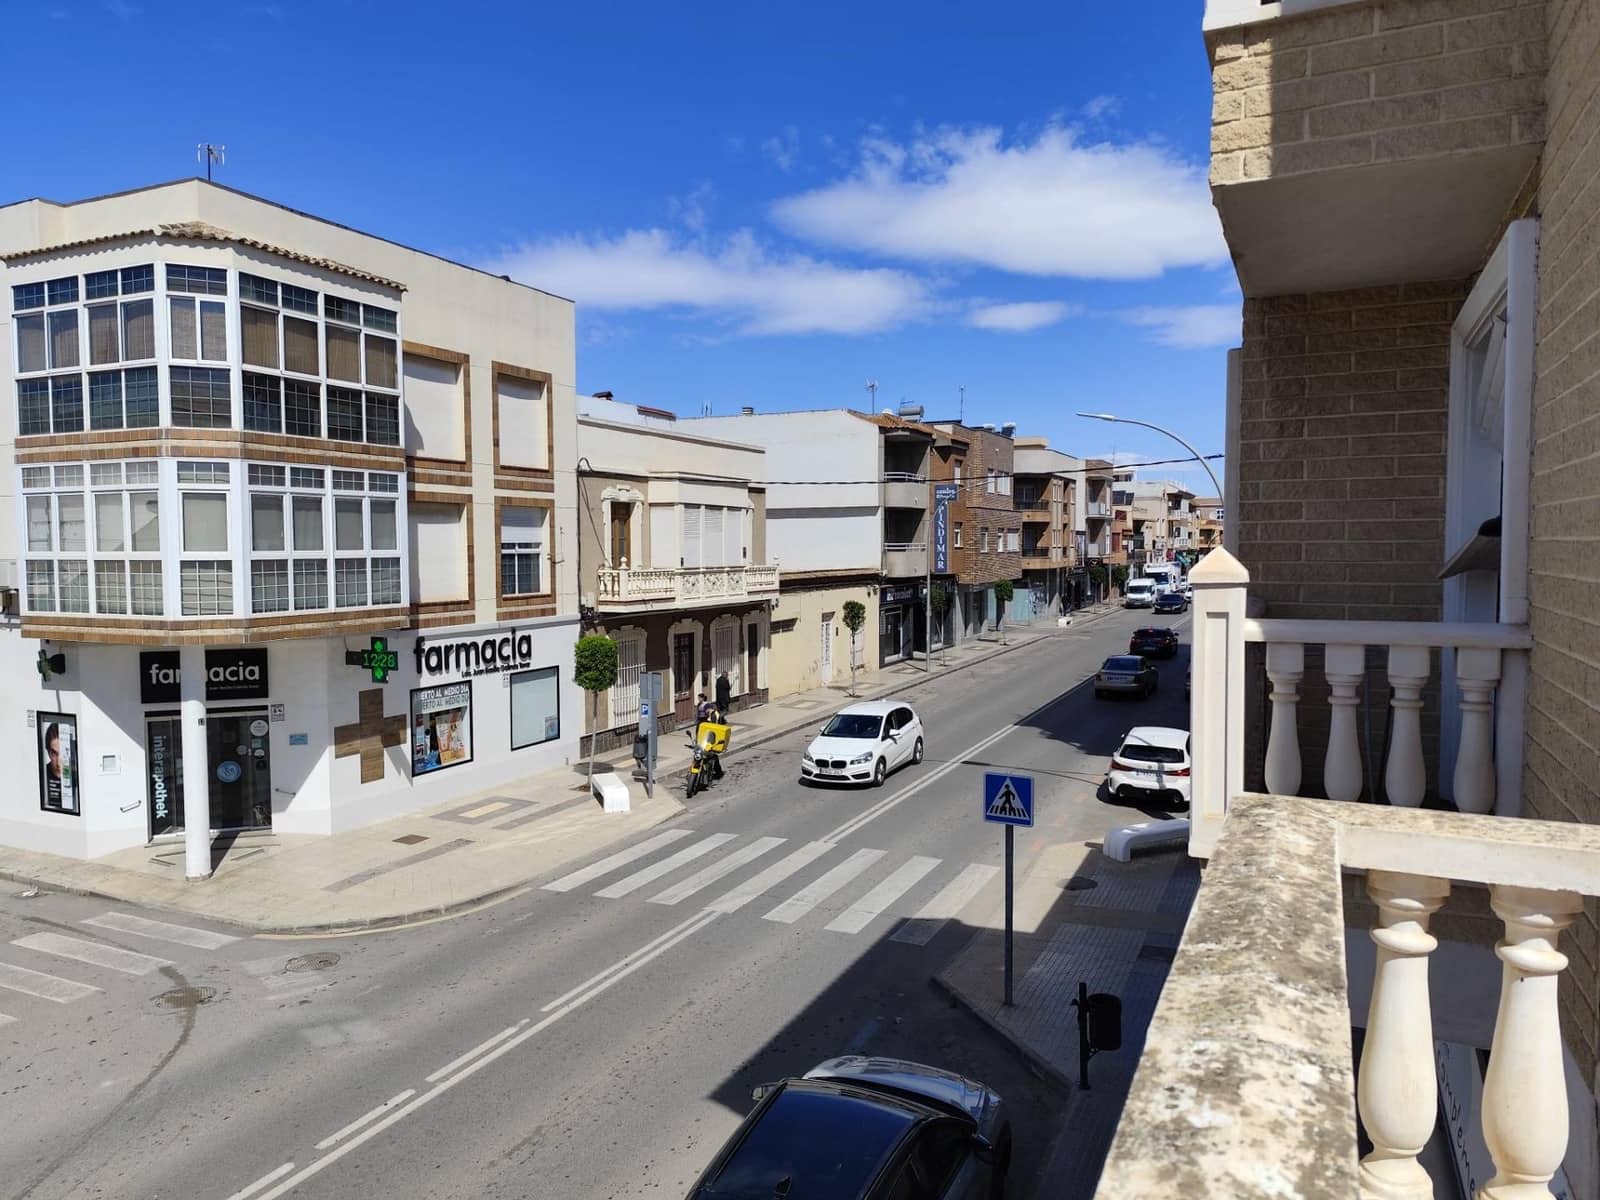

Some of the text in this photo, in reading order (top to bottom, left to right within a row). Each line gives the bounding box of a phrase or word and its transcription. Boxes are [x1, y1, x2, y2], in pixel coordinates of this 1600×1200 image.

[149, 661, 260, 685] faracia
[413, 627, 532, 675] farmacia
[152, 735, 168, 819] interapothek
